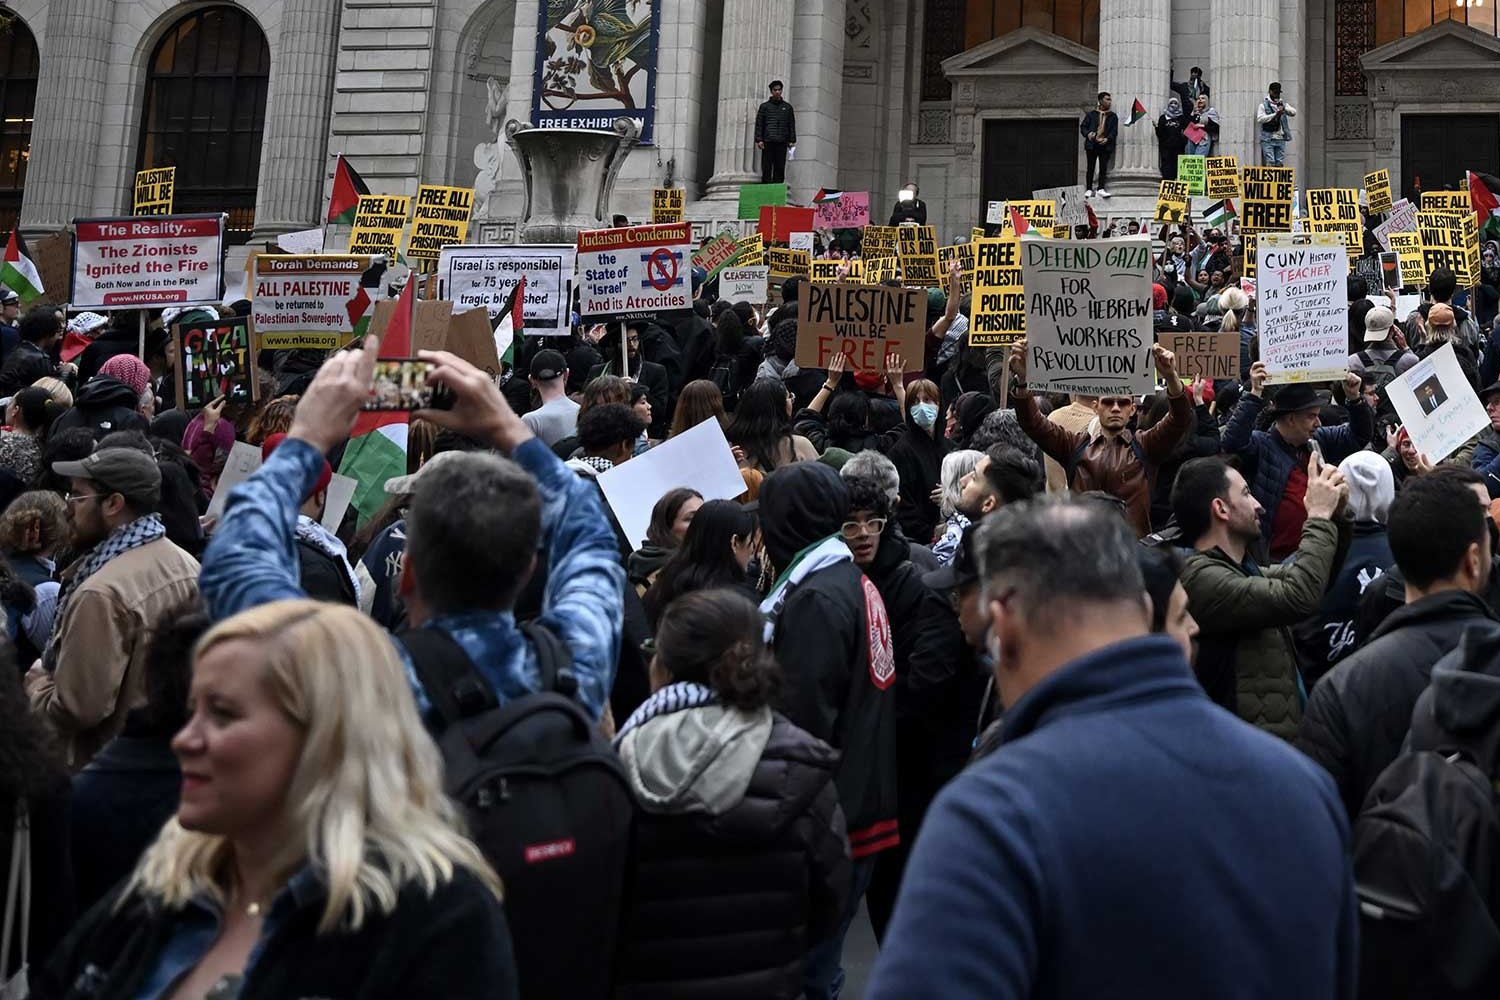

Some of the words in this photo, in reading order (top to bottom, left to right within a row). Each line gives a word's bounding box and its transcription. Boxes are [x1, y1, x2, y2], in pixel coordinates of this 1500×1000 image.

[136, 169, 175, 188] PALESTINE
[1243, 168, 1293, 183] PALESTINE
[1162, 182, 1187, 196] FREE
[1244, 183, 1274, 200] WILL
[1277, 183, 1292, 200] BE
[421, 189, 447, 206] FREE
[449, 191, 471, 209] ALL
[1311, 191, 1334, 205] END
[1336, 190, 1355, 205] ALL
[1422, 195, 1448, 209] FREE
[1450, 195, 1470, 209] ALL
[360, 199, 383, 215] FREE
[386, 201, 406, 215] ALL
[416, 207, 469, 222] PALESTINIAN
[1033, 204, 1053, 218] ALL
[1242, 202, 1291, 228] FREE!
[1313, 207, 1335, 221] U.S.
[1338, 206, 1356, 220] AID
[99, 224, 128, 237] The
[132, 221, 197, 237] Reality...
[356, 217, 404, 229] PALESTINIAN
[1418, 215, 1462, 230] PALESTINE
[417, 224, 460, 238] POLITICAL
[580, 231, 624, 248] Judaism
[626, 227, 686, 243] Condemns
[899, 227, 916, 241] END
[918, 227, 934, 240] ALL
[1421, 230, 1449, 247] WILL
[1451, 232, 1465, 247] BE
[357, 233, 395, 246] POLITICAL
[99, 246, 128, 259] The
[132, 243, 199, 258] Zionists
[598, 253, 616, 264] the
[978, 244, 1015, 267] FREE
[1028, 243, 1101, 270] DEFEND
[1105, 246, 1148, 270] GAZA
[271, 260, 304, 270] Torah
[306, 259, 359, 270] Demands
[453, 259, 483, 272] Israel
[485, 260, 495, 271] is
[498, 259, 559, 273] responsible
[1265, 250, 1306, 269] CUNY
[1310, 252, 1337, 265] HISTORY
[86, 261, 141, 278] Ignited
[147, 260, 173, 273] the
[177, 258, 209, 271] Fire
[586, 269, 616, 281] State
[618, 266, 629, 279] of
[1278, 264, 1331, 283] TEACHER
[257, 281, 281, 297] ALL
[283, 280, 351, 296] PALESTINE
[1060, 277, 1096, 300] FOR
[111, 292, 181, 304] www.NKUSA.org
[588, 298, 610, 312] And
[612, 297, 624, 310] its
[626, 295, 685, 308] Atrocities
[808, 286, 918, 325] PALESTINE
[256, 314, 300, 326] Palestinian
[302, 312, 344, 327] Sovereignty
[835, 322, 865, 338] WILL
[870, 323, 887, 339] BE
[1056, 325, 1142, 349] WORKERS
[267, 335, 336, 347] www.nkusa.org
[1174, 336, 1218, 354] FREE
[818, 336, 901, 370] FREE
